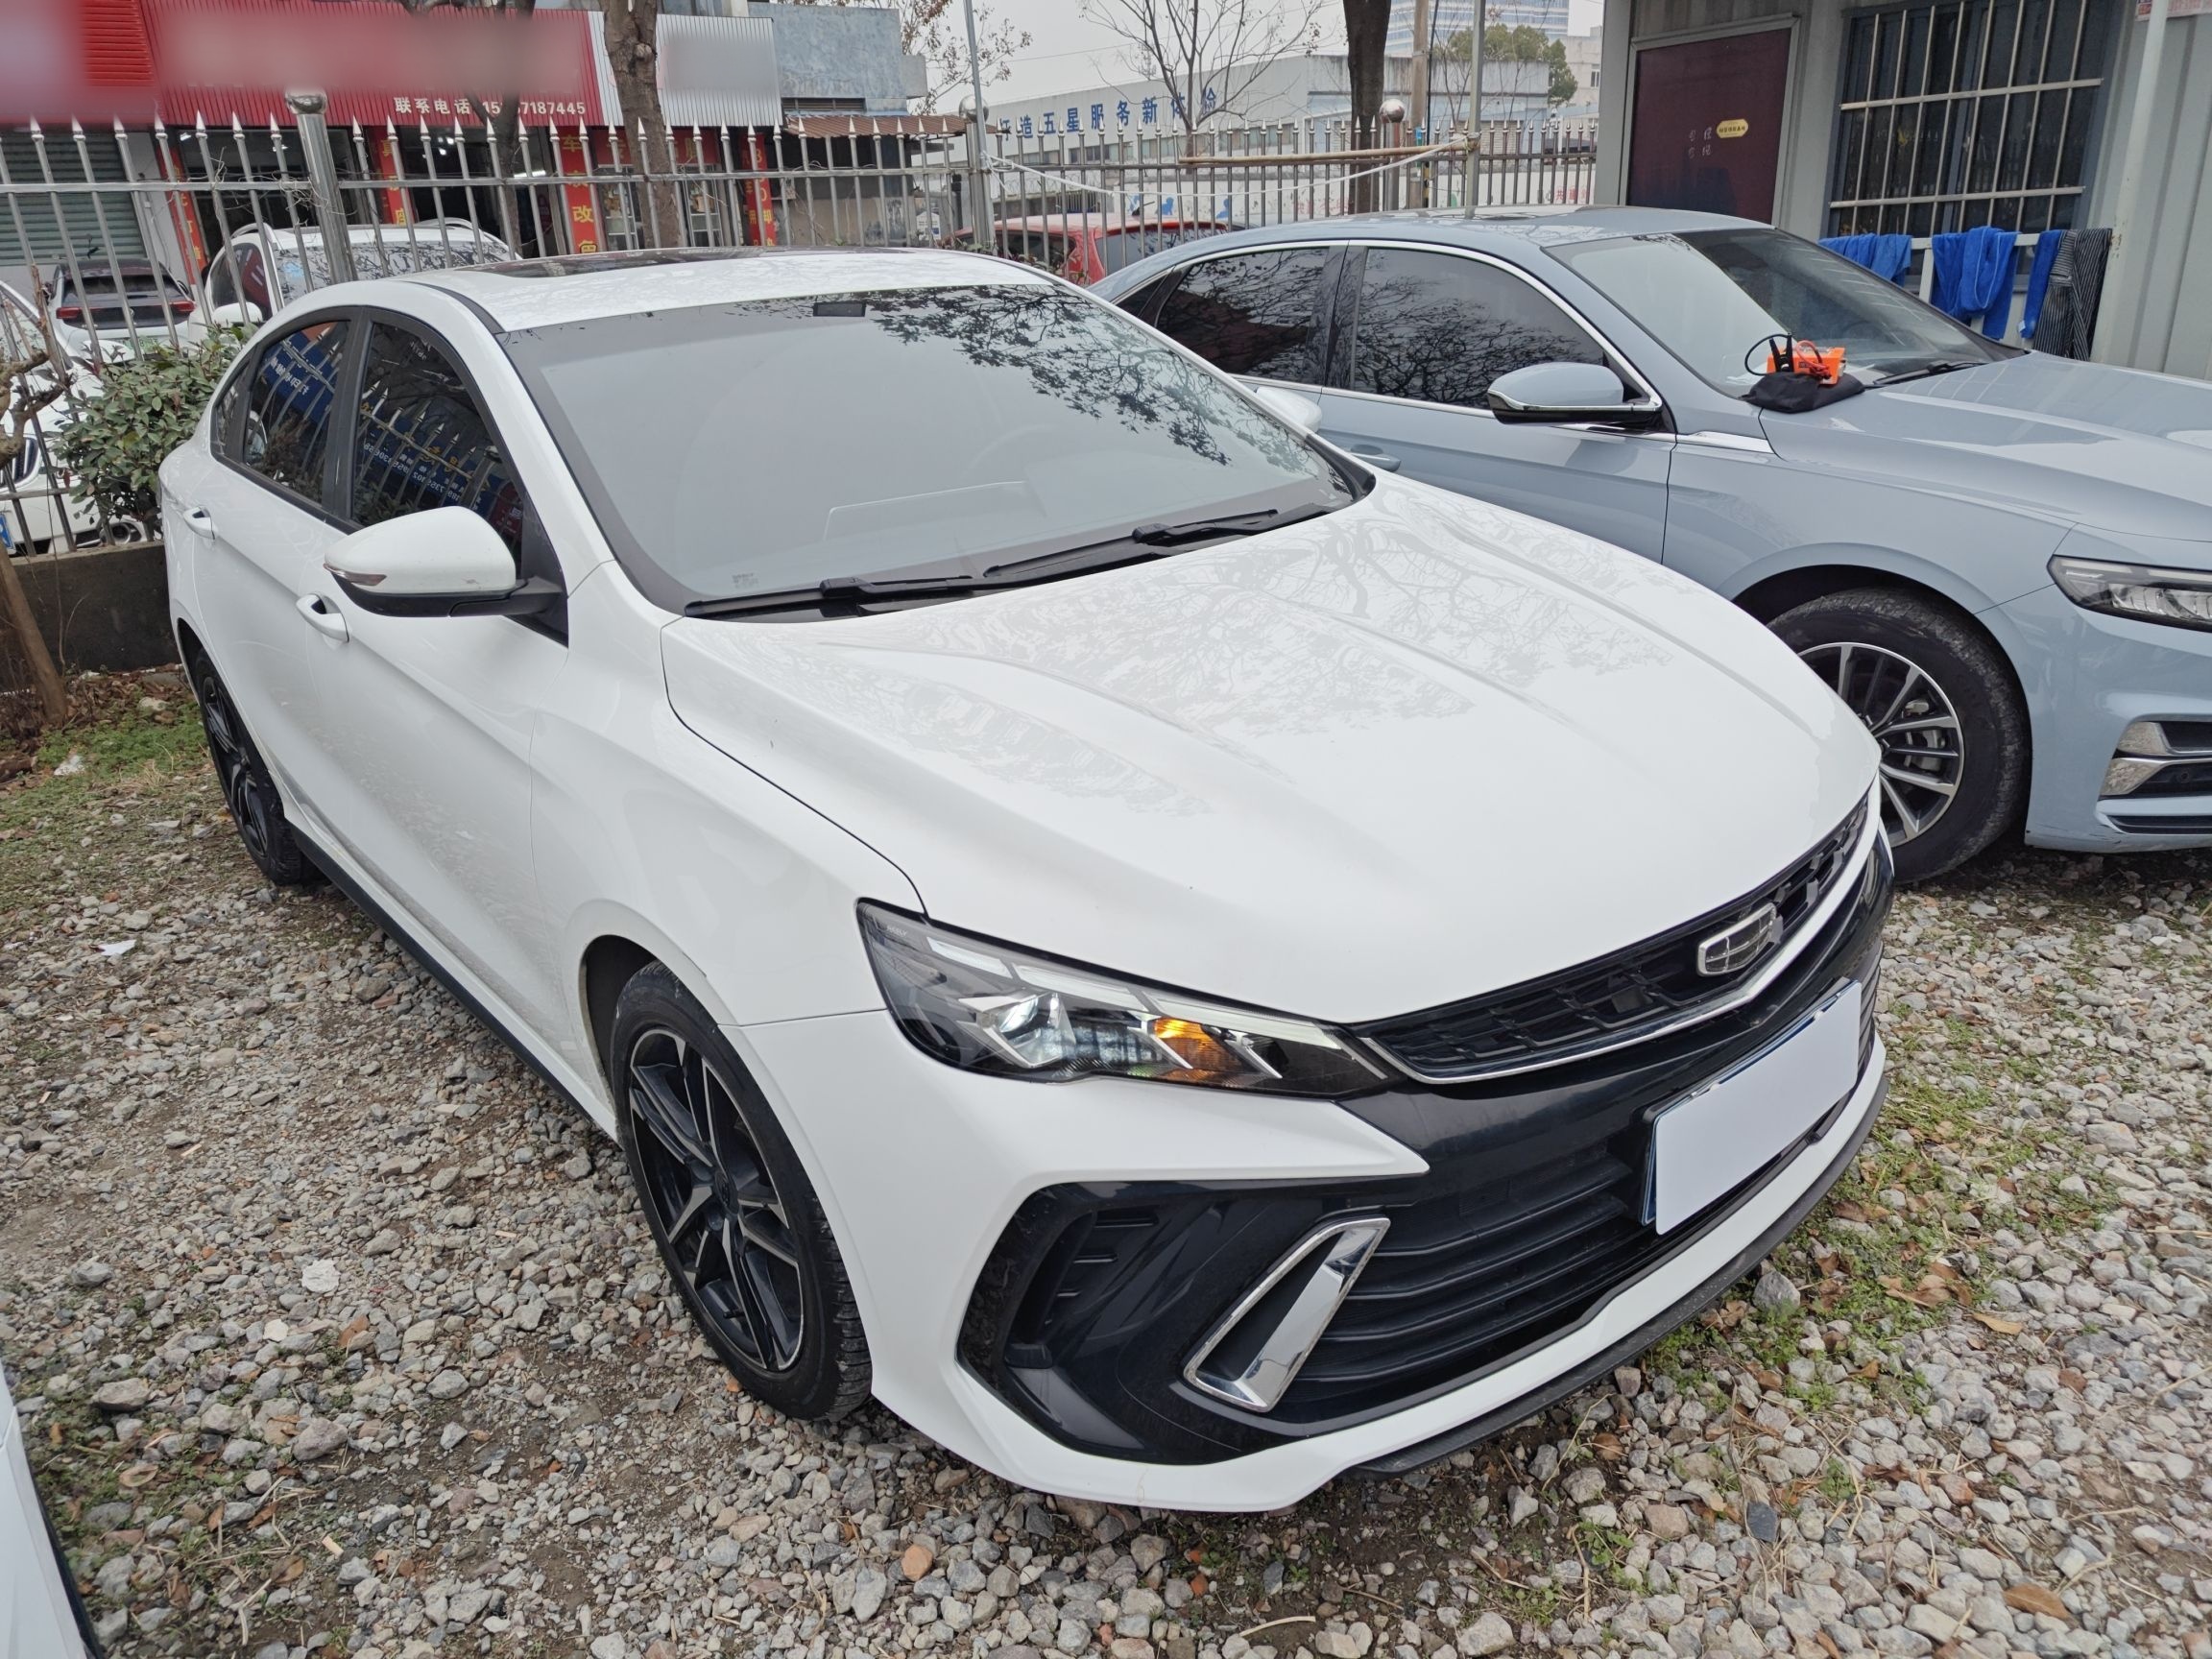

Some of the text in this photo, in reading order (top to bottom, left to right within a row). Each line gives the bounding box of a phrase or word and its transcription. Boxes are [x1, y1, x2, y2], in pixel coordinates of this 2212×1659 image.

[394, 97, 586, 115] 联系电话 157187445
